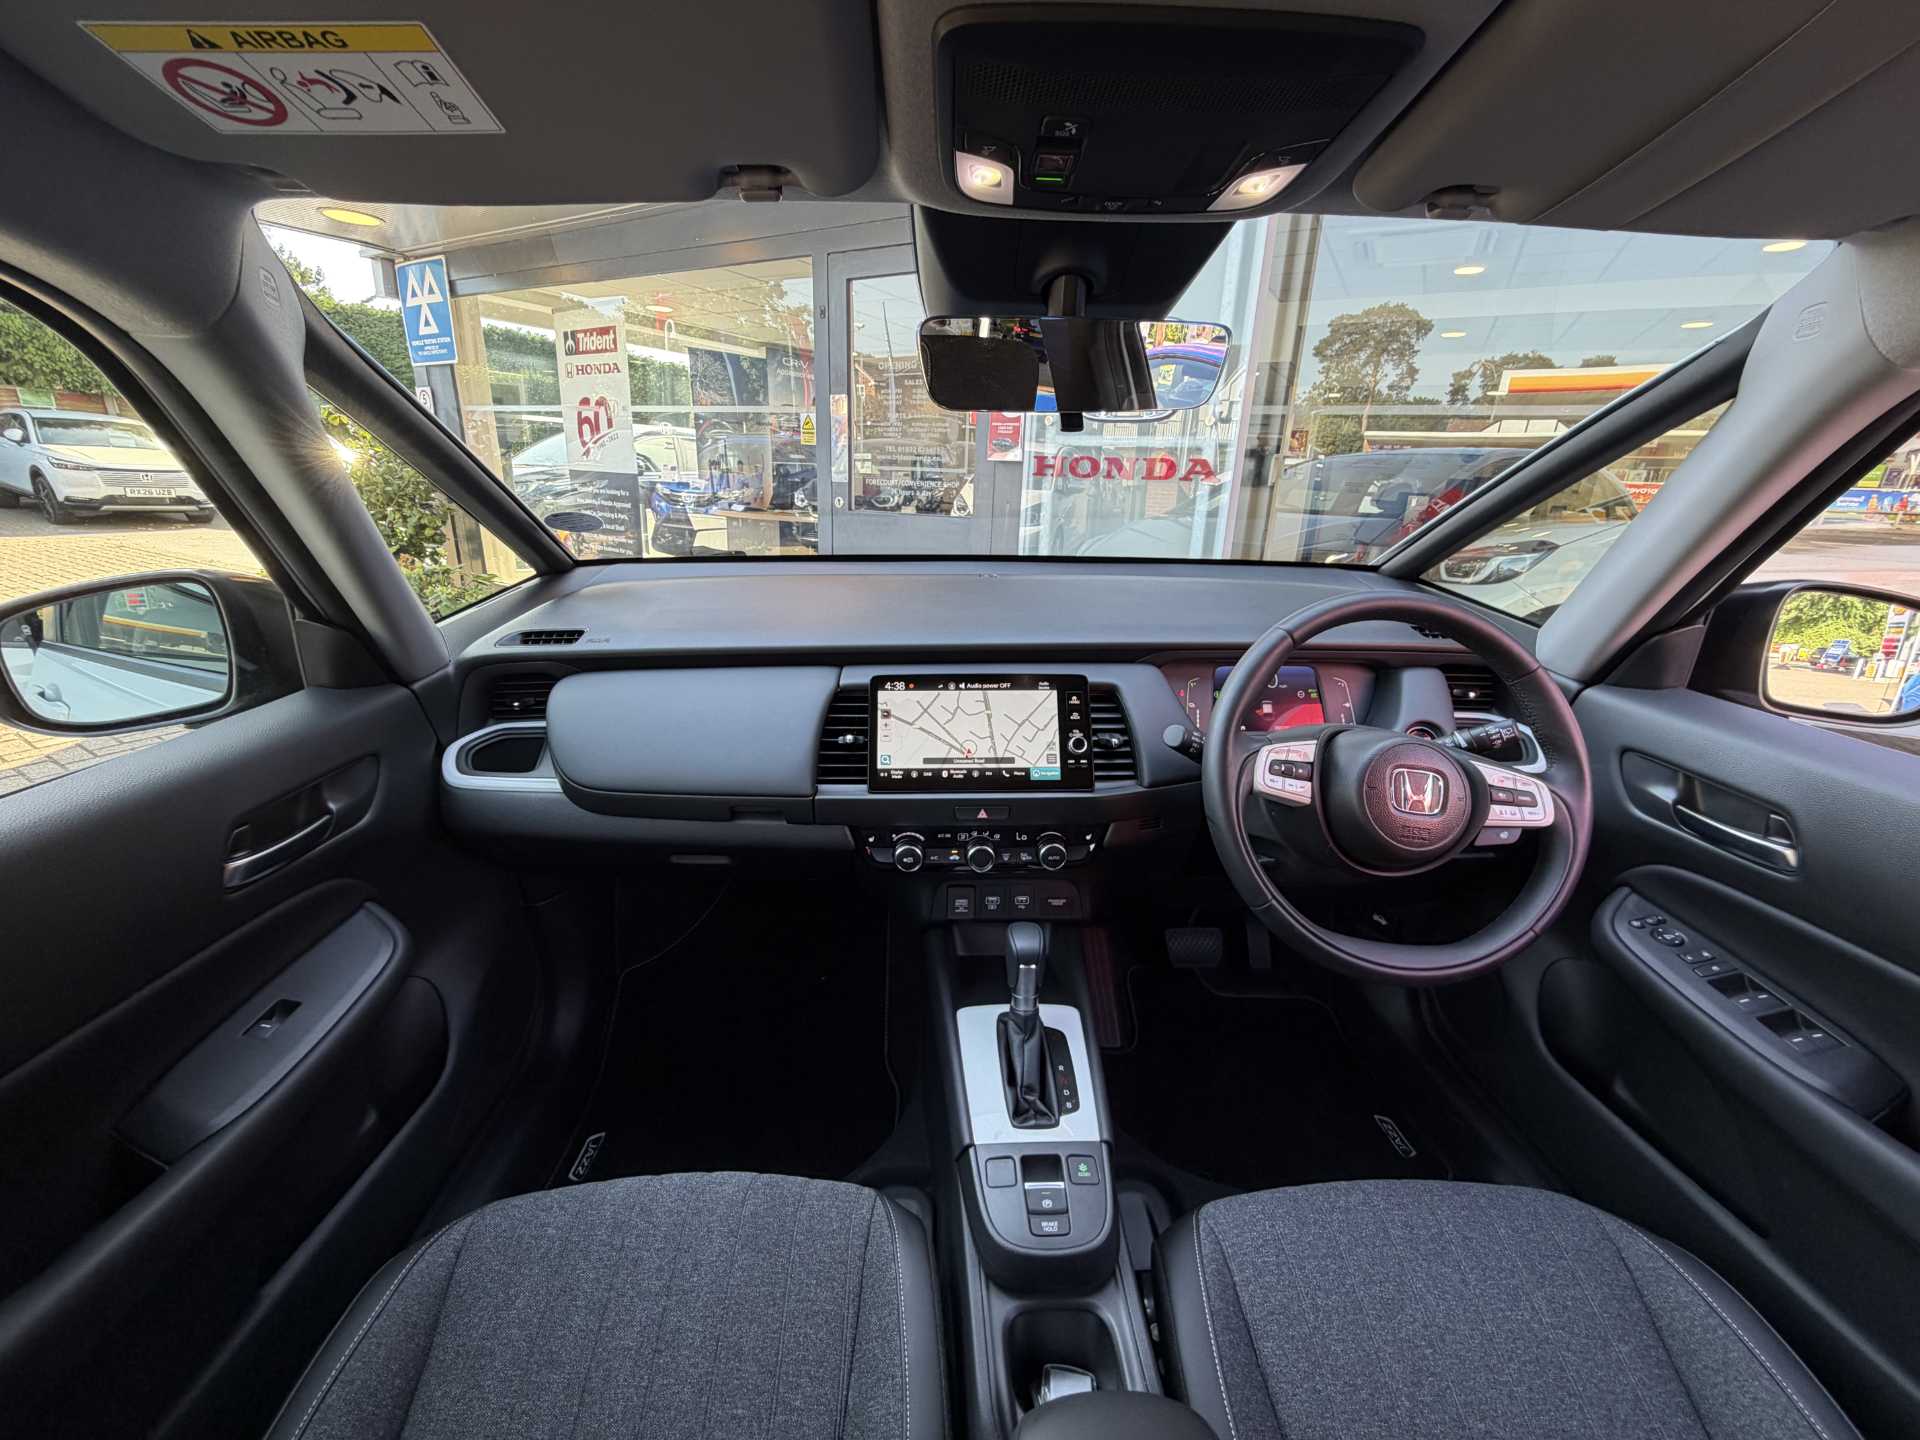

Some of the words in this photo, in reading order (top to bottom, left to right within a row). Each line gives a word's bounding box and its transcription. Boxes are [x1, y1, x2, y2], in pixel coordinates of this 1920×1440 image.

[229, 30, 349, 50] AIRBAG
[577, 330, 615, 351] Trident
[575, 362, 621, 376] HONDA
[1032, 455, 1221, 484] HONDA
[884, 682, 906, 691] 4:38
[1058, 1064, 1065, 1072] R
